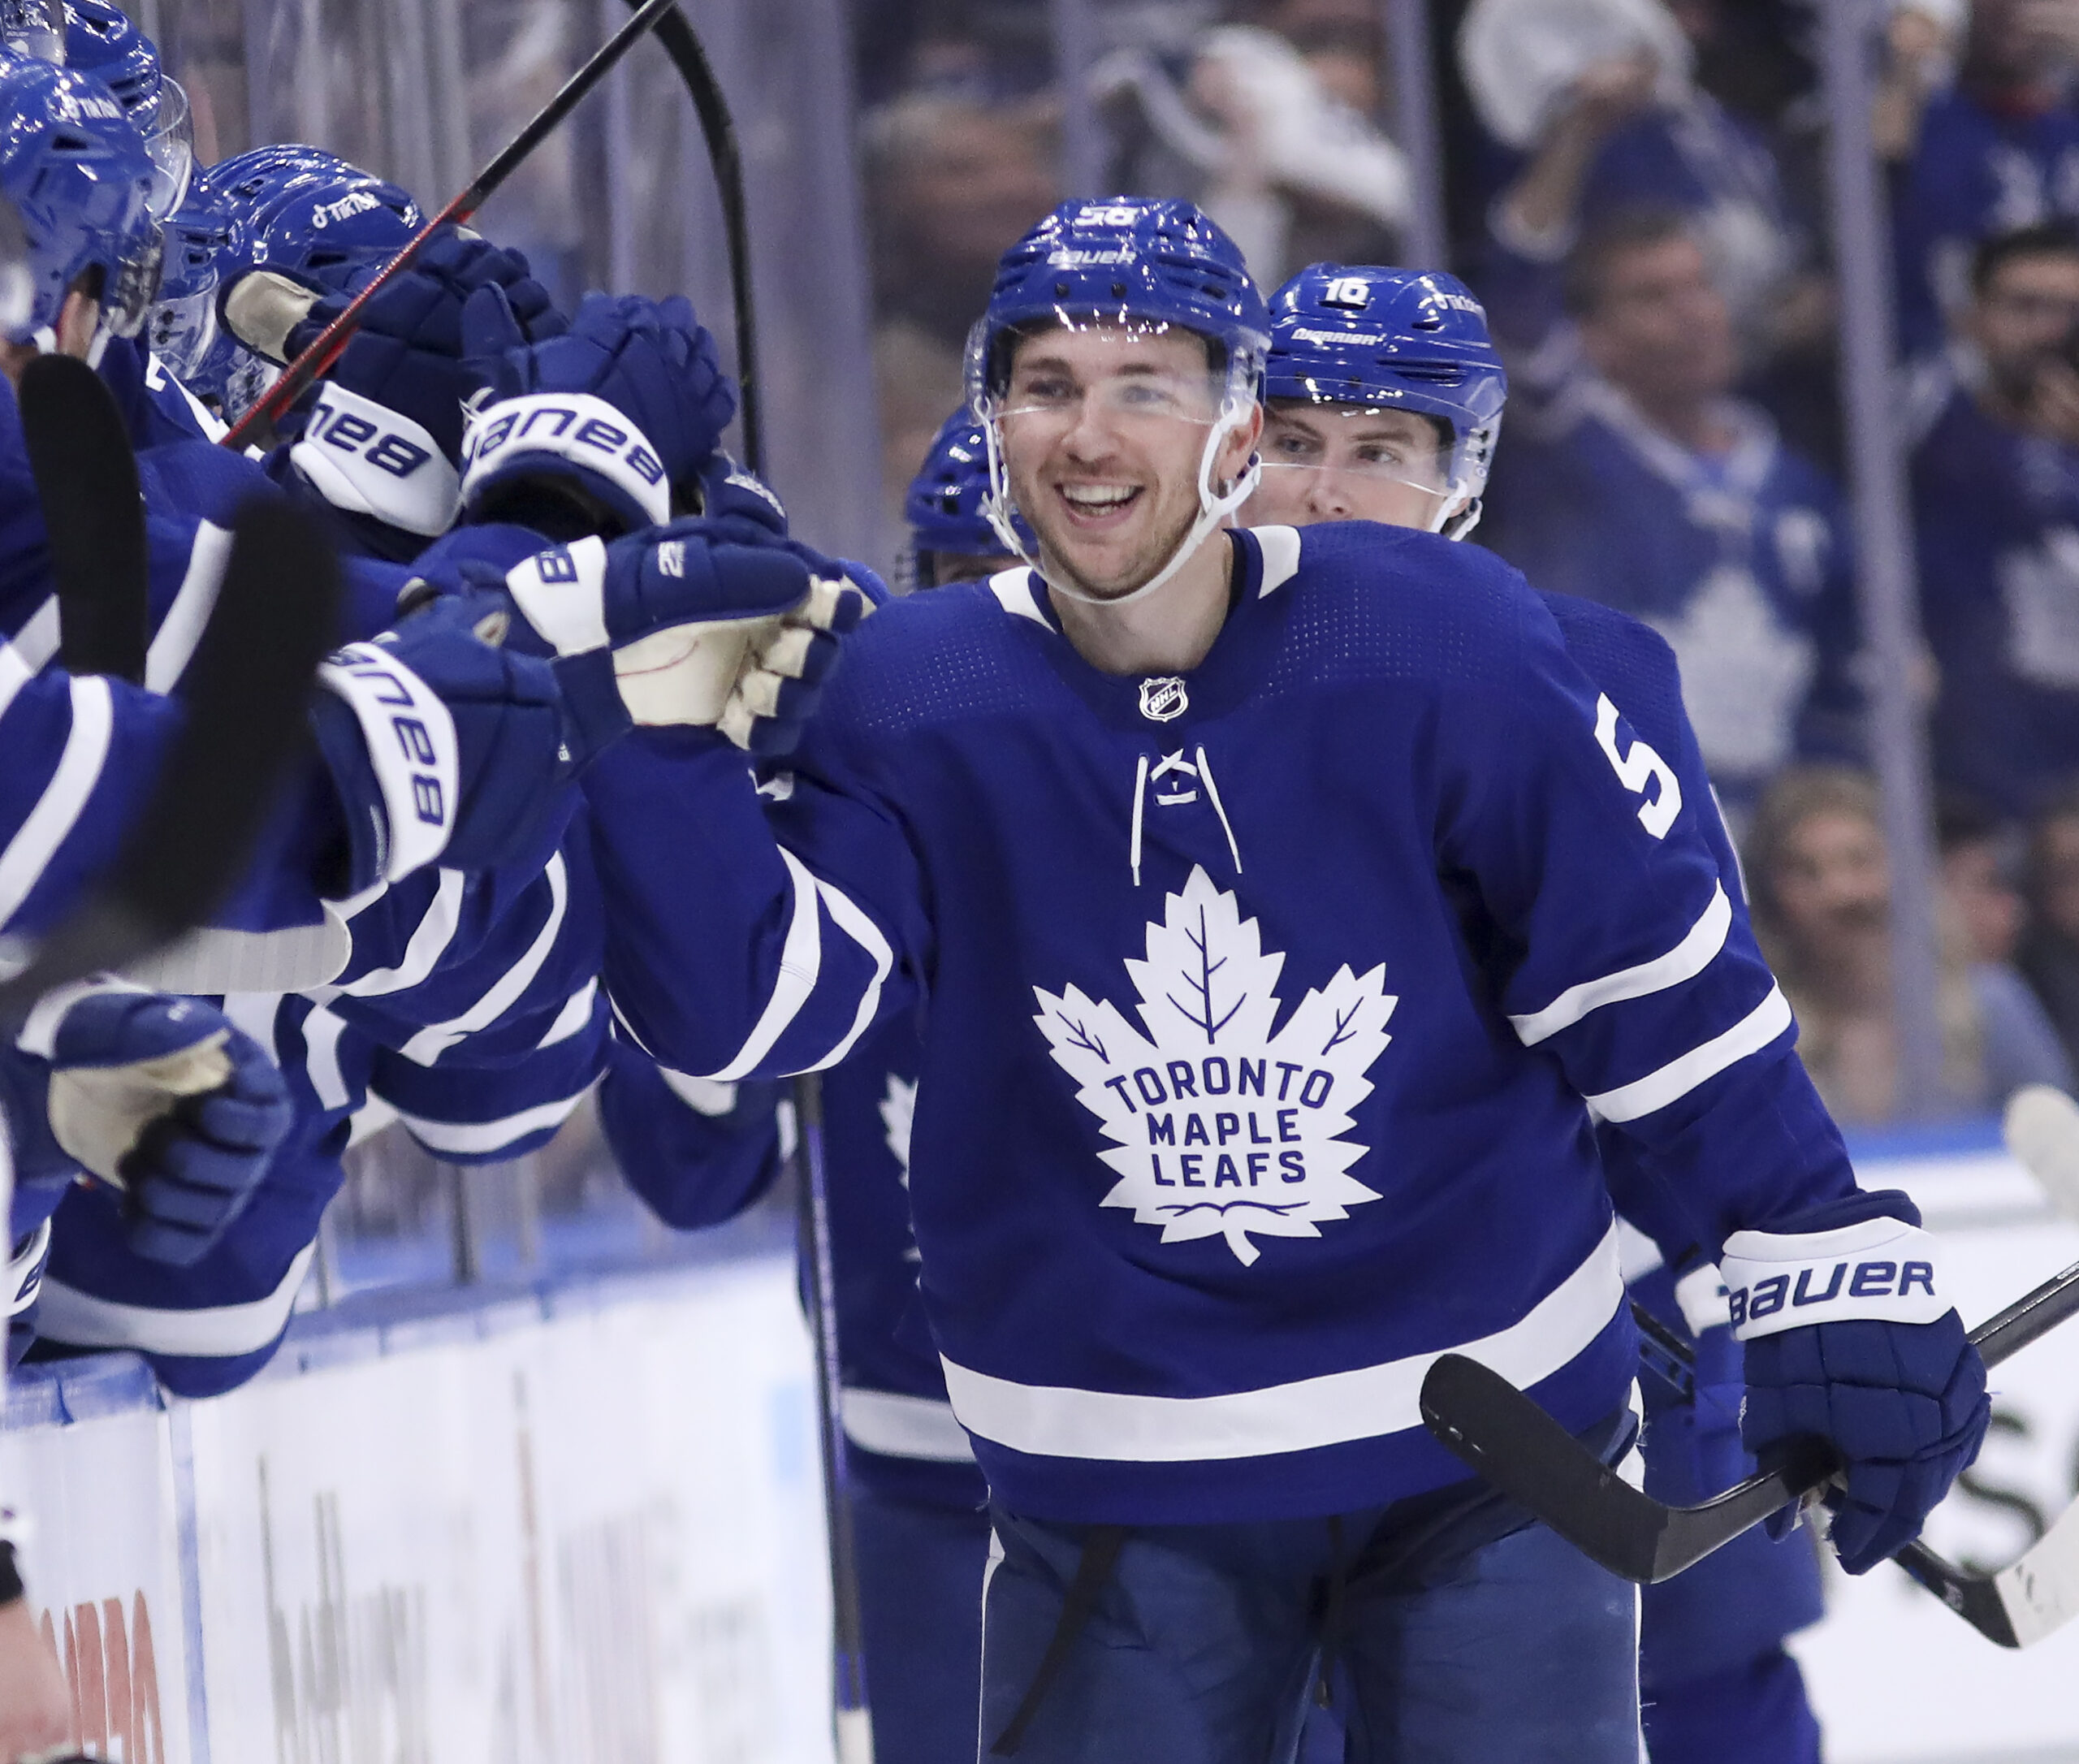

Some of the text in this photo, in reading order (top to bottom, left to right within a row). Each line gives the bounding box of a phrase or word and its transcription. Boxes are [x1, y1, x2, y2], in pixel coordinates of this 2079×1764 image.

[1325, 278, 1371, 306] 16
[1149, 687, 1178, 713] NHL
[1104, 1057, 1334, 1113] TORONTO
[1146, 1109, 1302, 1146] MAPLE
[1152, 1151, 1307, 1187] LEAFS
